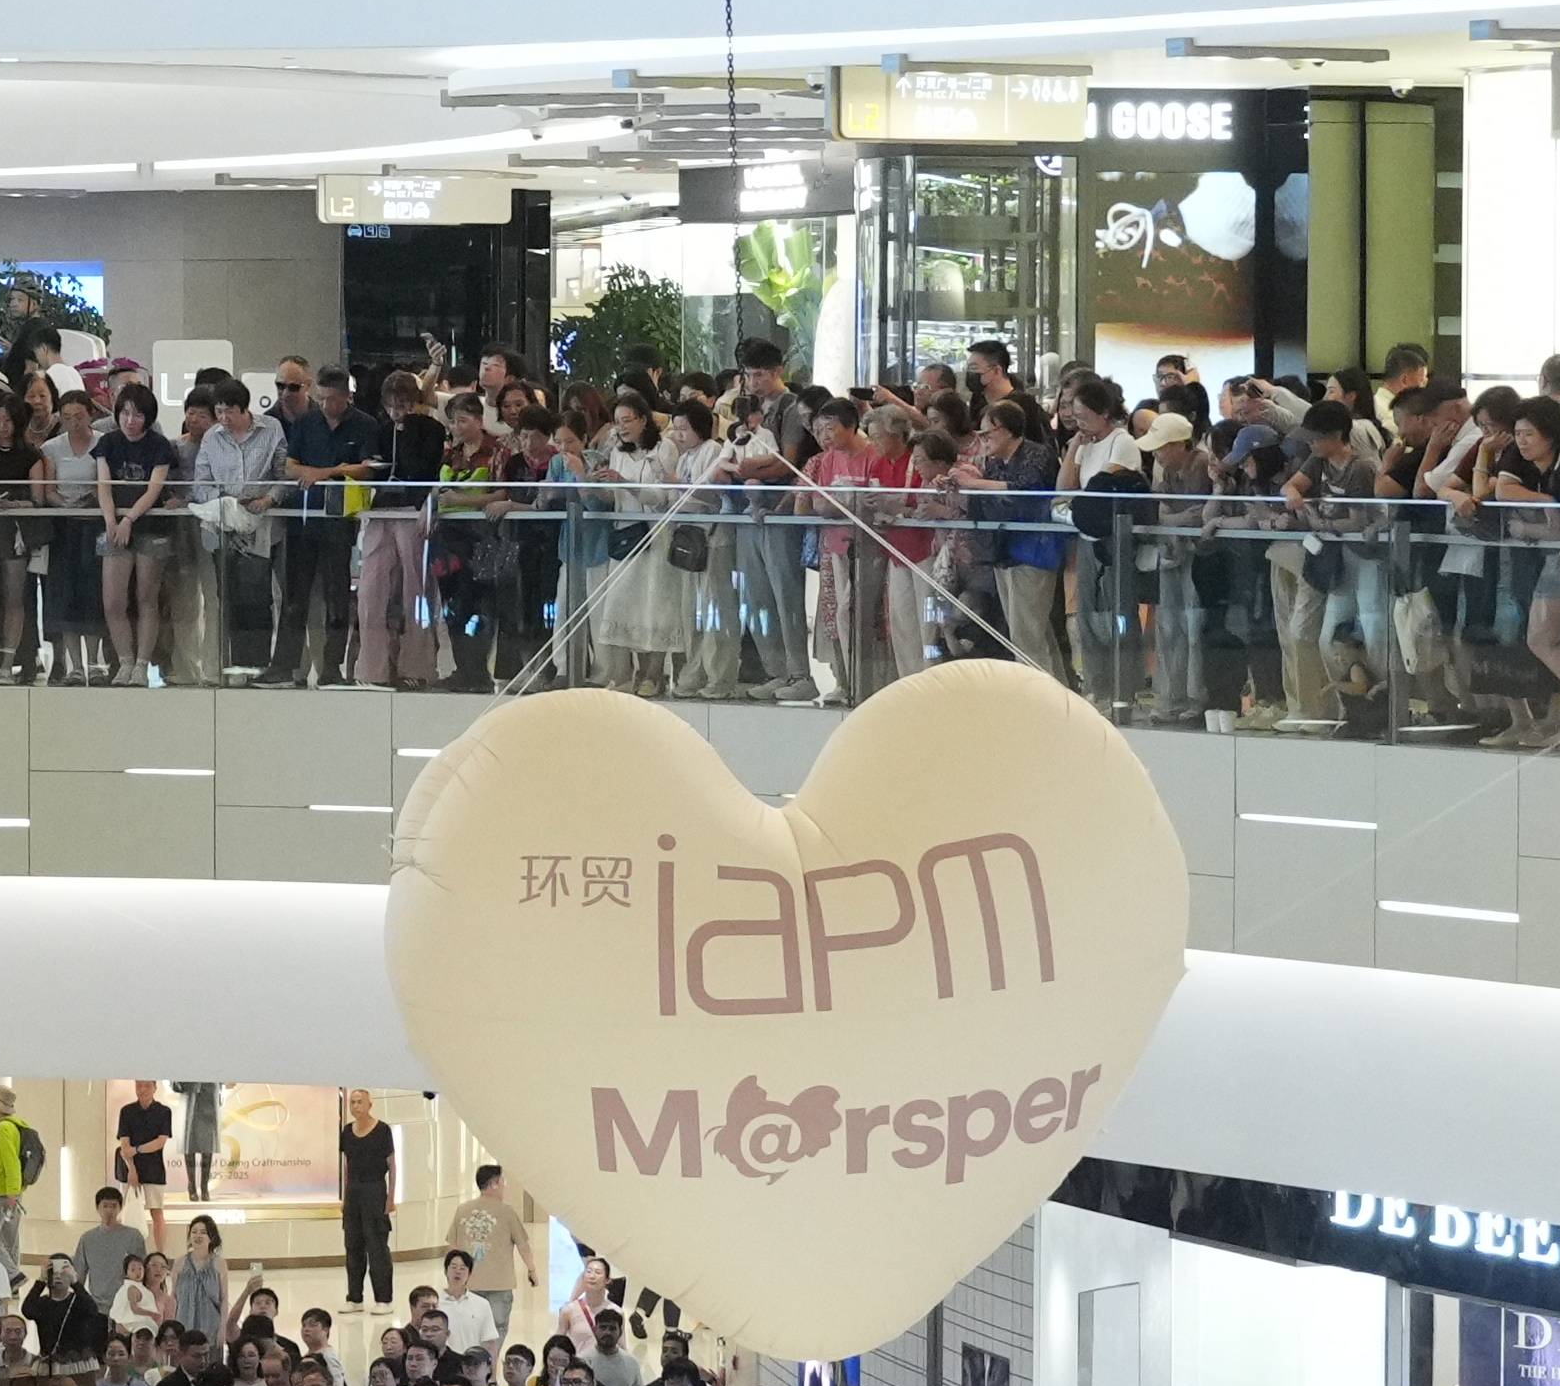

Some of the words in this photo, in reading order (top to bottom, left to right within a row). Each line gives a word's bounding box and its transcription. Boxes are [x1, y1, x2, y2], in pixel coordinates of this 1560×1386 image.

[848, 102, 881, 132] L2
[1111, 101, 1233, 140] GOOSE
[330, 196, 355, 217] L2
[518, 854, 633, 908] 环贸
[656, 832, 1056, 1017] iapm
[1329, 1190, 1416, 1239] DE
[1518, 1364, 1548, 1380] THE
